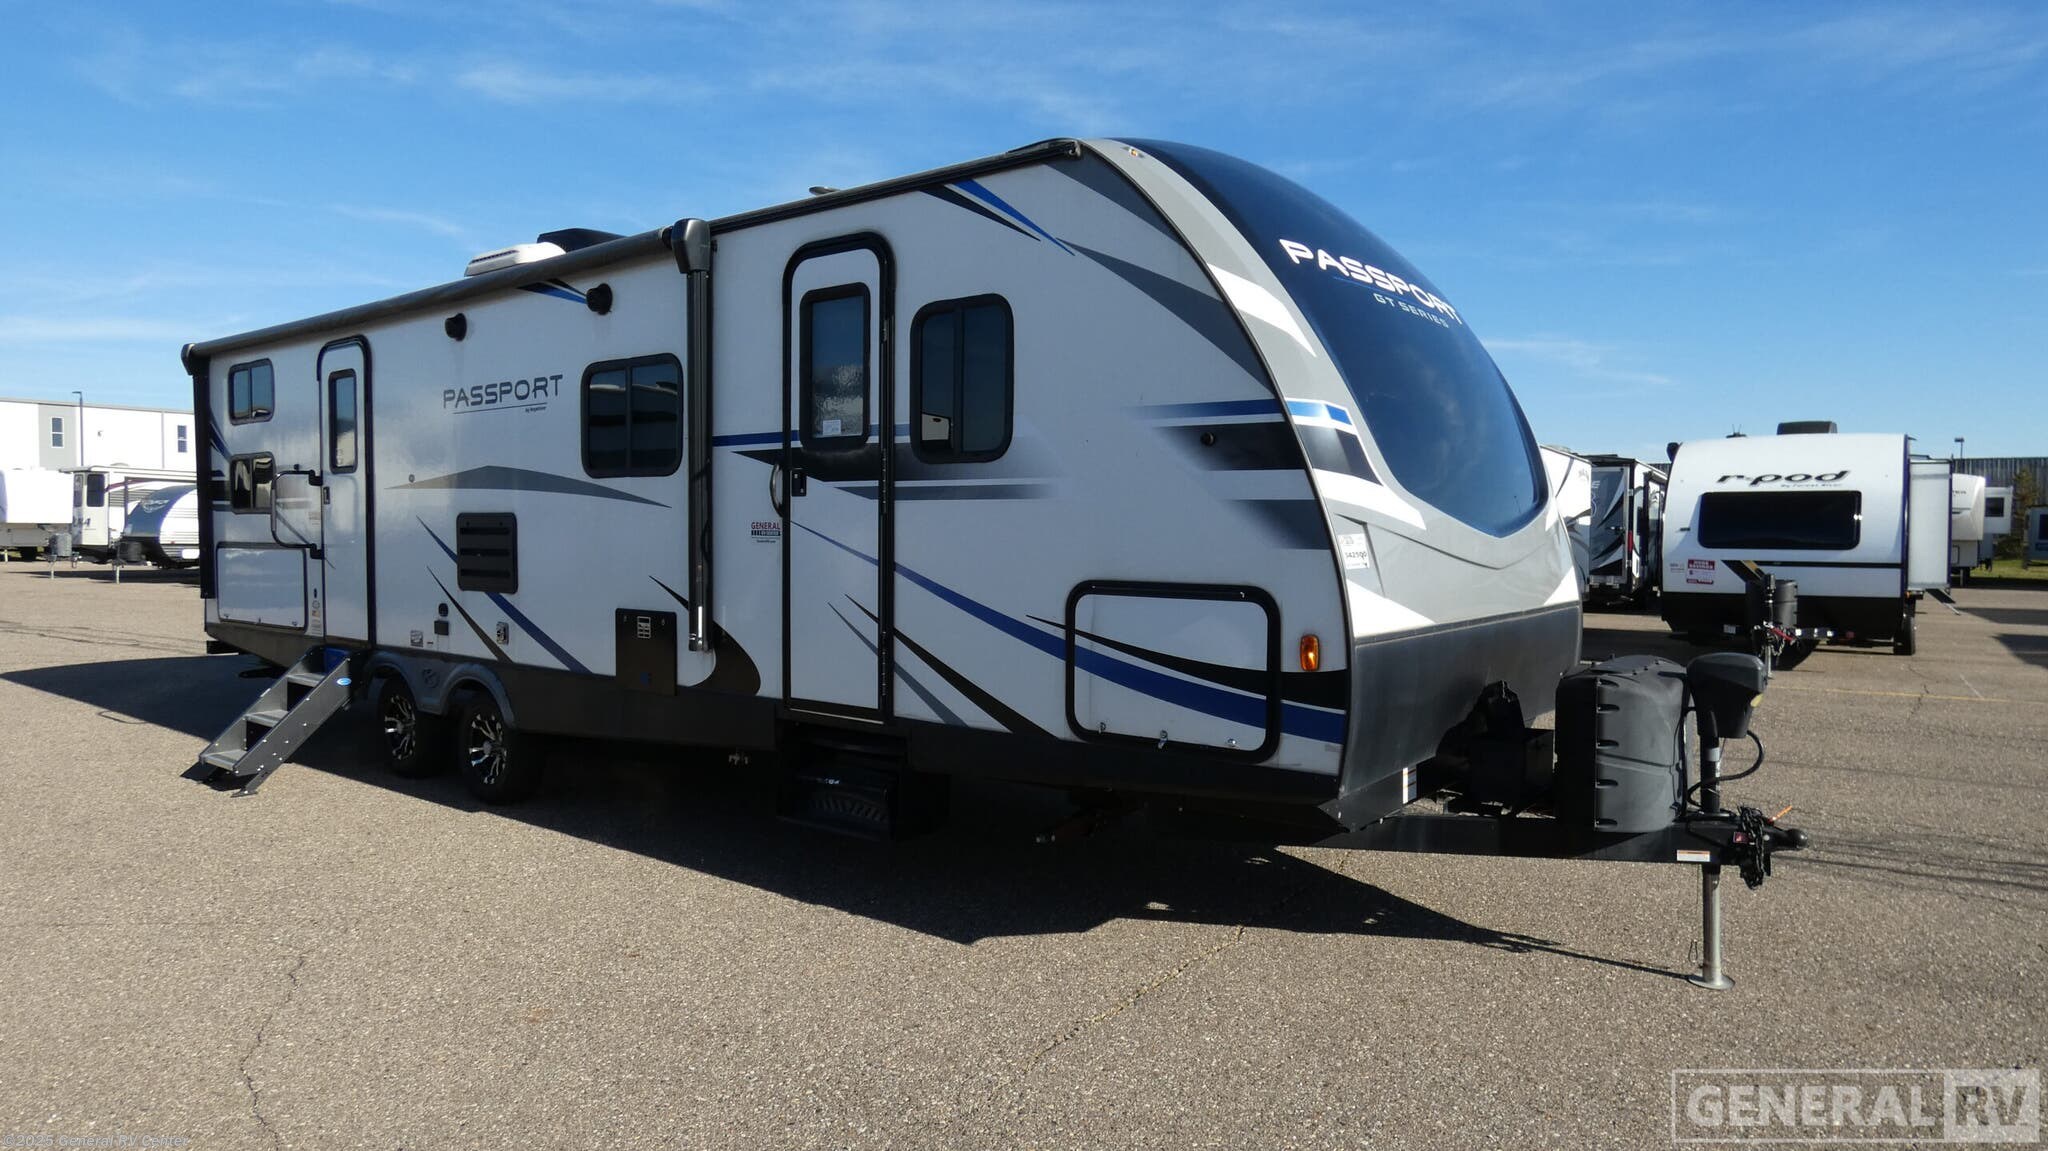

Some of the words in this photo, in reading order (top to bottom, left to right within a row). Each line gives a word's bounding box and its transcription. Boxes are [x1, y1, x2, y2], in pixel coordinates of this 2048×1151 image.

[1279, 238, 1463, 325] PASSPORT
[1373, 293, 1396, 308] GT
[1399, 301, 1449, 329] SERIES
[443, 374, 563, 408] PASSPORT
[751, 521, 780, 530] GENERAL
